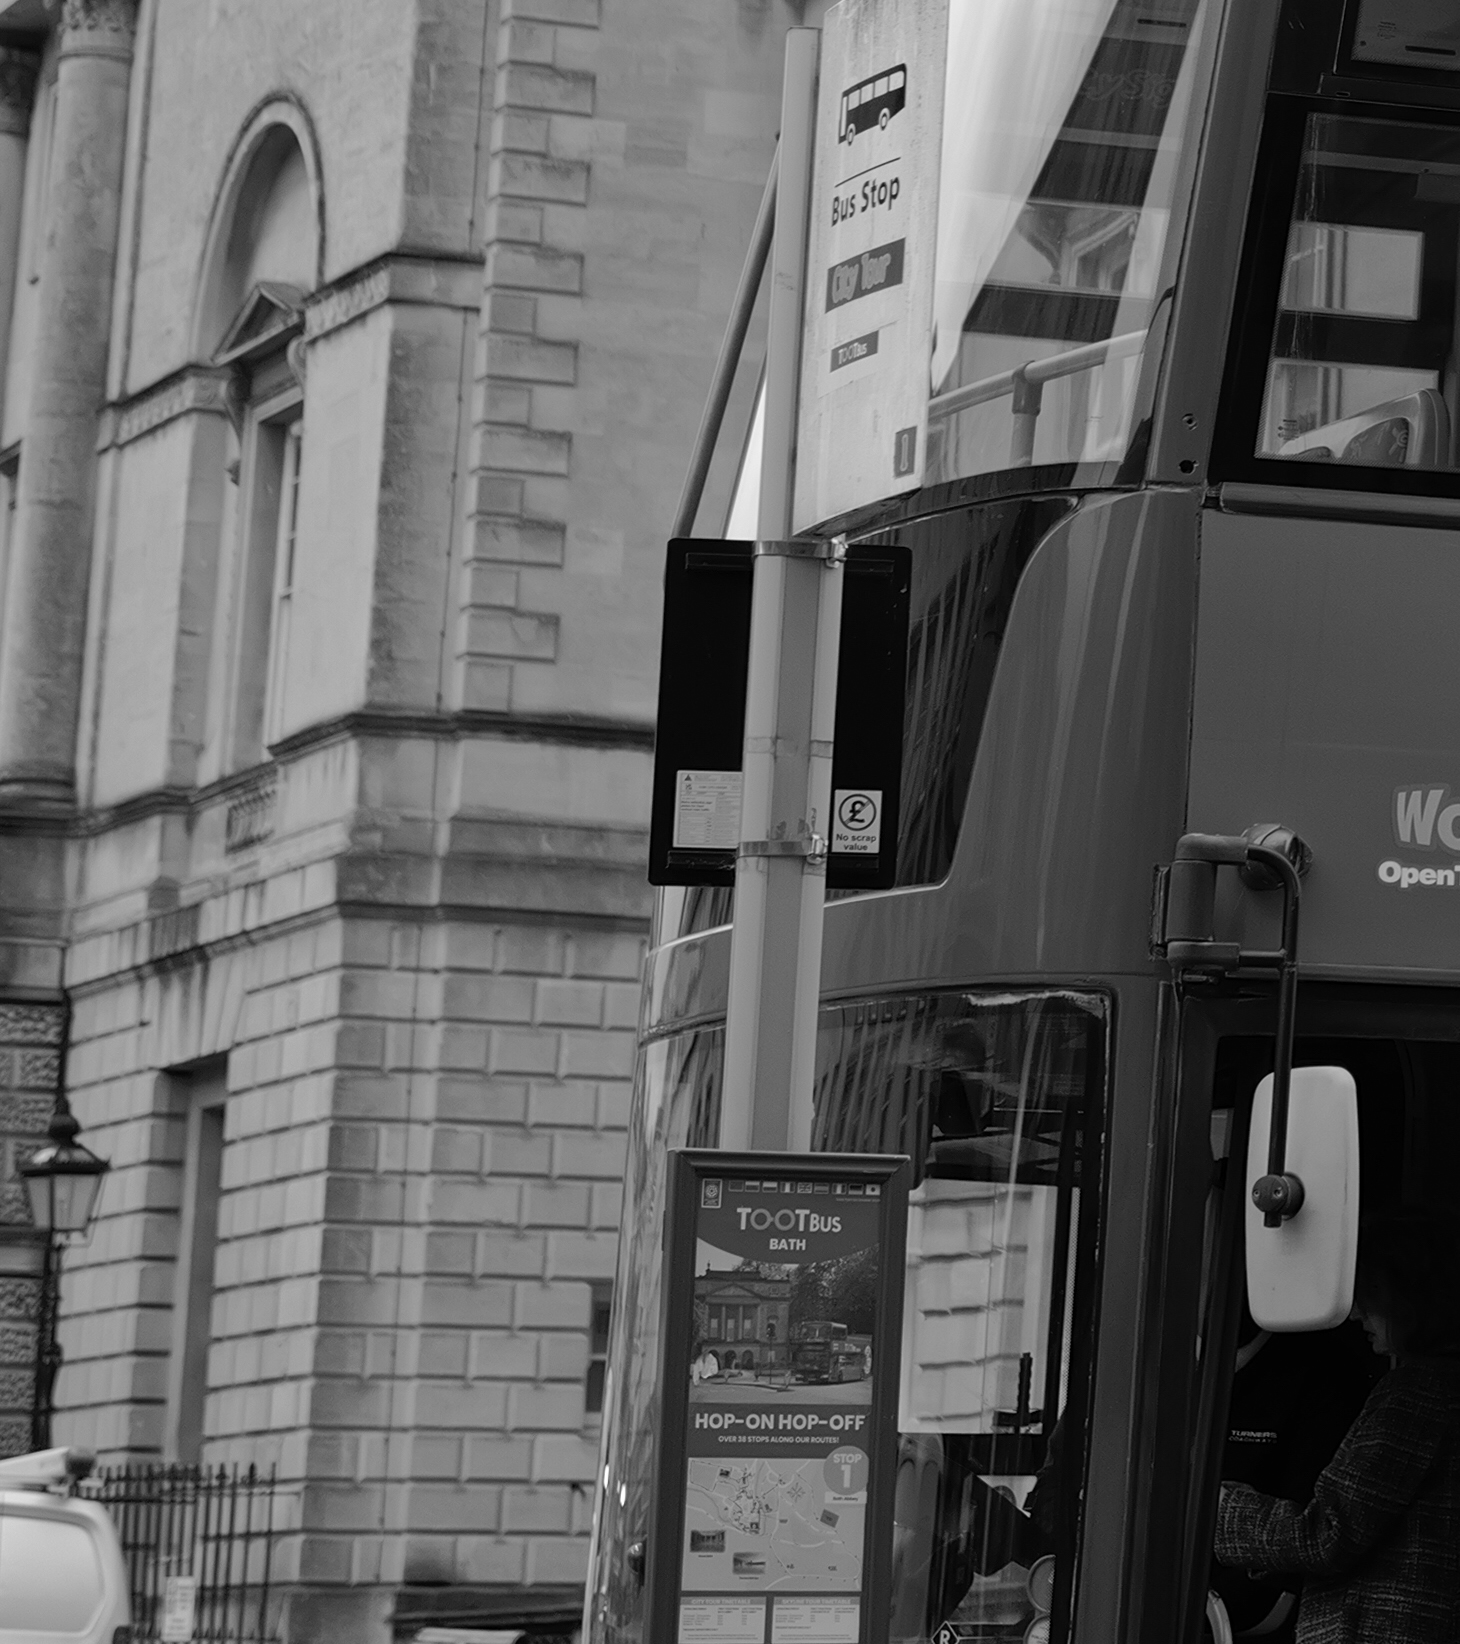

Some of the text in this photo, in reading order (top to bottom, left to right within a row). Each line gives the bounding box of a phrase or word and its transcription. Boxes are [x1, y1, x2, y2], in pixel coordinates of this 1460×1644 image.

[831, 175, 901, 228] Bus Stop
[832, 252, 892, 304] City Tour
[836, 833, 877, 844] No scrap
[843, 843, 868, 851] value
[769, 1238, 807, 1251] BATH
[695, 1413, 866, 1431] HOP-ON HOP-OFF
[718, 1435, 737, 1443] OVER
[810, 1436, 840, 1444] ROUTES!
[833, 1453, 862, 1464] STOP
[841, 1464, 852, 1488] 1
